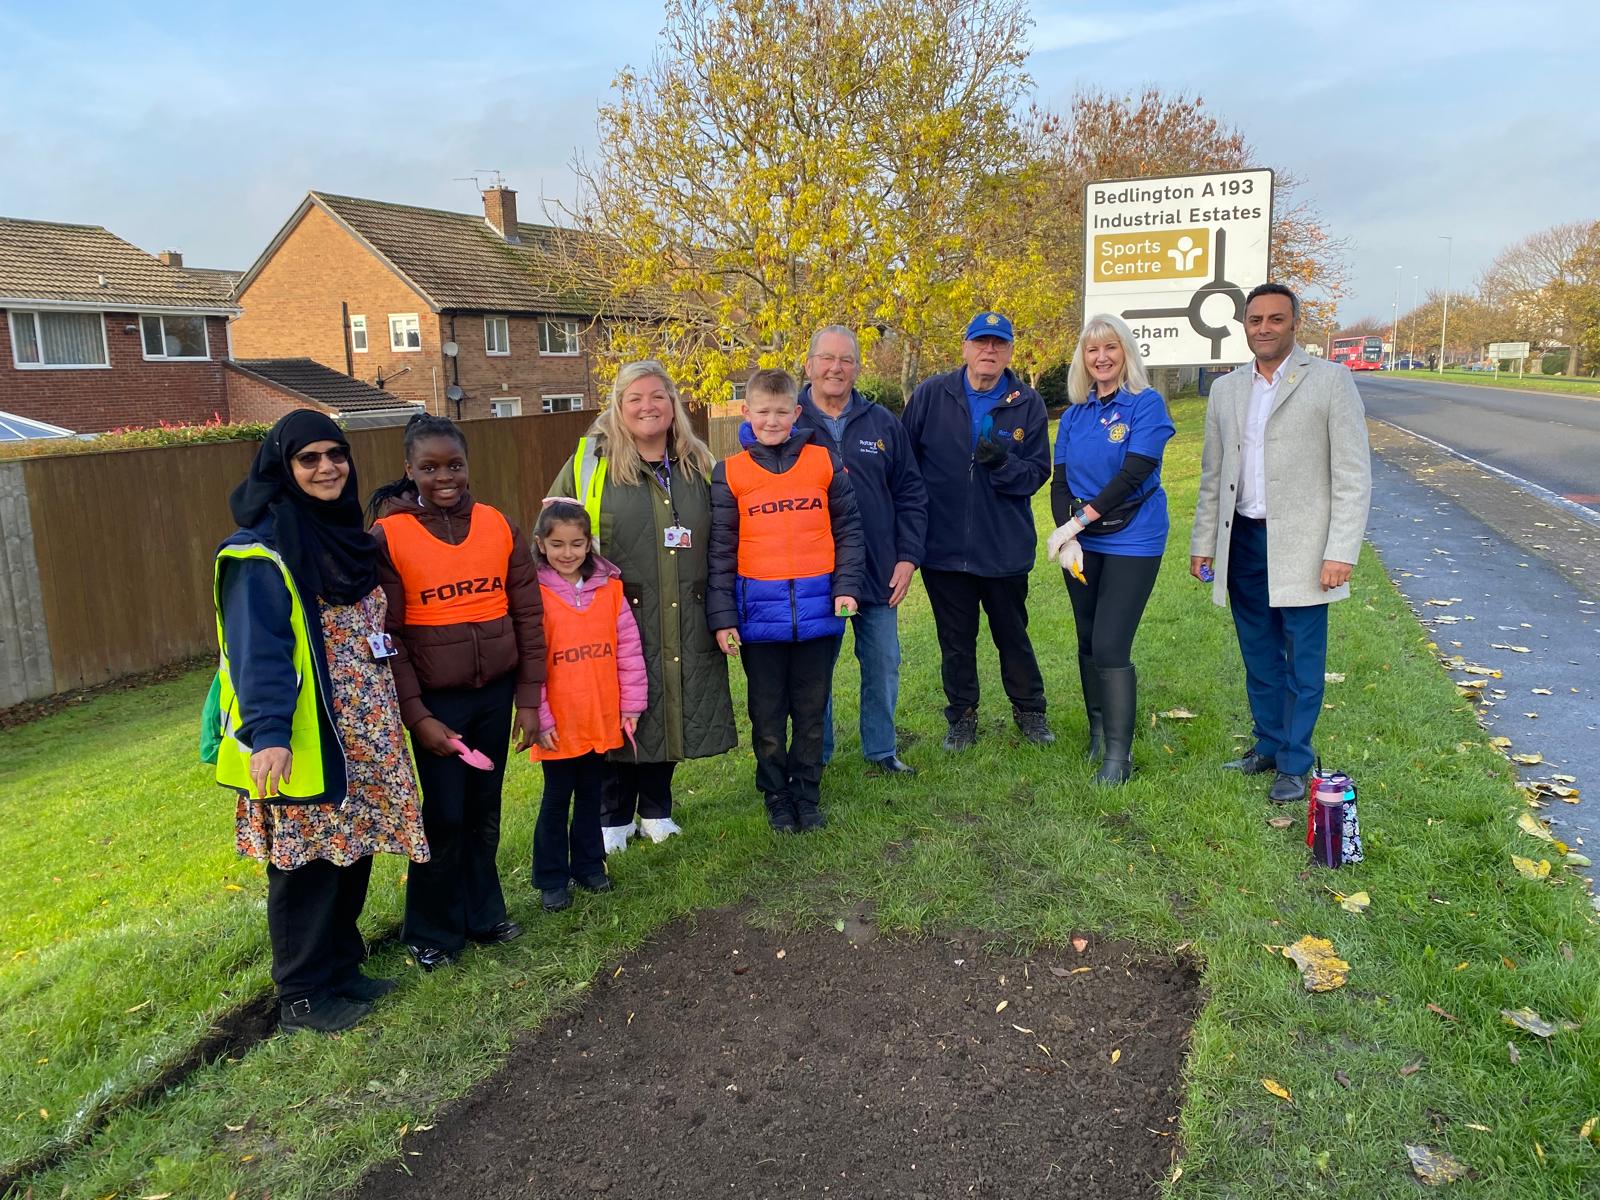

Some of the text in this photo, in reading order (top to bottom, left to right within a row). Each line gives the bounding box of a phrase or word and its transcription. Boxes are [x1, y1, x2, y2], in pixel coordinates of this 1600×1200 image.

[1094, 179, 1254, 205] Bedlington A 193
[1094, 205, 1262, 229] Industrial Estates
[1101, 240, 1161, 258] Sports
[1101, 260, 1162, 276] Centre
[1132, 325, 1179, 339] sham
[747, 497, 823, 517] FORZA
[419, 576, 504, 605] FORZA
[552, 642, 613, 666] FORZA
